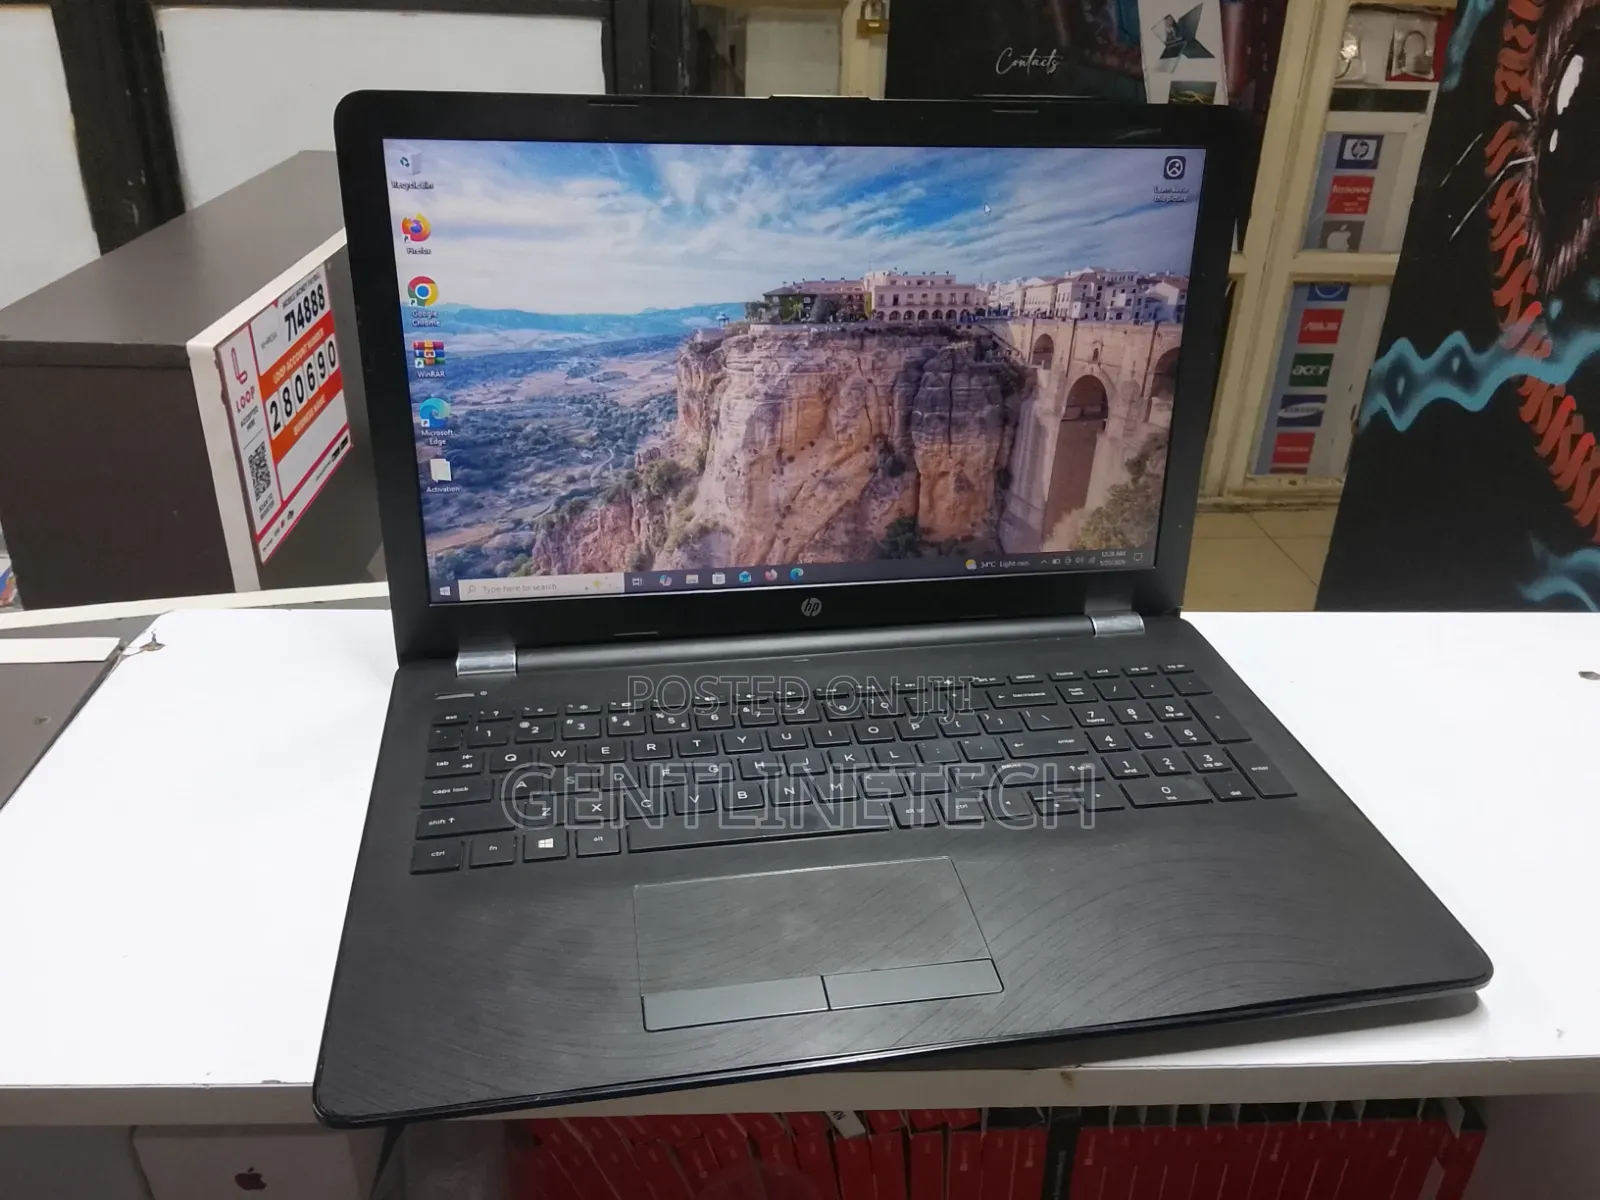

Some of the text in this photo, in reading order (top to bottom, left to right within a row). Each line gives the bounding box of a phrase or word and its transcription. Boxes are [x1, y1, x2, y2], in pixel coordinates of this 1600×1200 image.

[995, 46, 1063, 74] Contacts
[283, 281, 326, 343] 714888
[1292, 365, 1329, 375] acer
[235, 384, 256, 414] LOOP
[429, 438, 447, 446] Edge
[482, 585, 500, 594] Type
[503, 585, 521, 593] here
[532, 583, 557, 591] search
[801, 597, 822, 617] hp
[531, 726, 539, 734] 2
[868, 726, 879, 734] O
[1184, 729, 1194, 737] 6
[647, 743, 657, 751] R
[505, 754, 517, 762] Q
[551, 750, 566, 758] W
[844, 754, 855, 762] K
[890, 751, 899, 759] L
[754, 761, 764, 769] H
[803, 758, 809, 766] J
[708, 765, 719, 773] G
[566, 776, 575, 784] S
[614, 773, 624, 781] D
[784, 787, 795, 795] N
[830, 783, 842, 791] M
[689, 795, 699, 803] V
[737, 791, 748, 799] B
[542, 808, 551, 816] Z
[592, 804, 602, 812] X
[428, 818, 446, 826] shift
